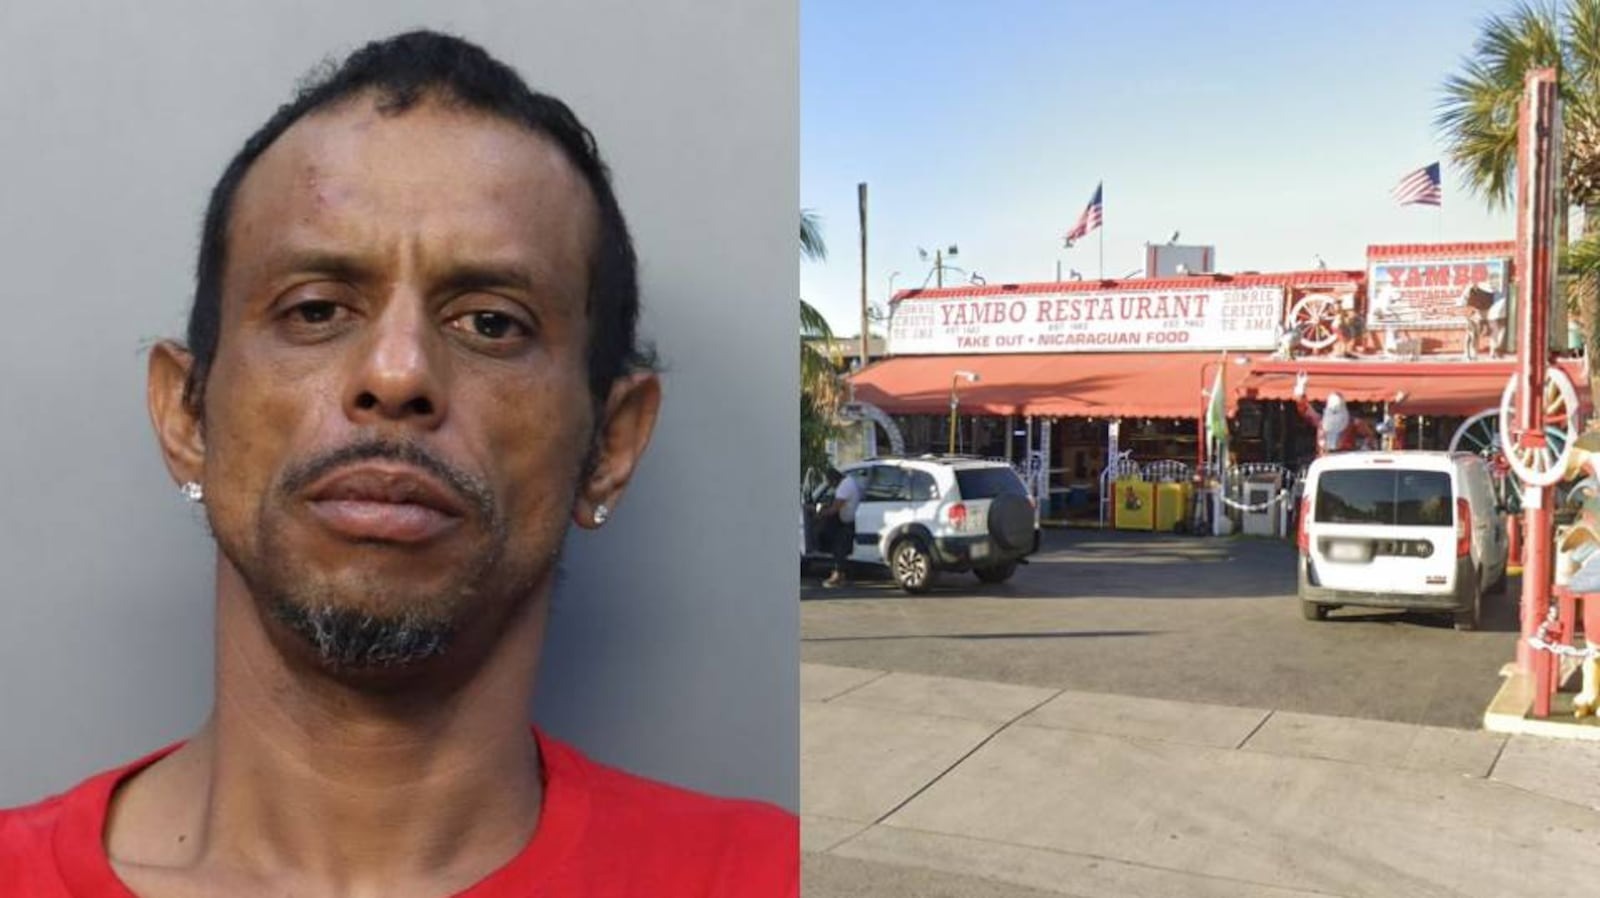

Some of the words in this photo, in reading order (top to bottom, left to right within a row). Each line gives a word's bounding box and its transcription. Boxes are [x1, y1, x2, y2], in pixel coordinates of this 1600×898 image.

[1387, 264, 1488, 287] YAMBO
[940, 301, 1026, 325] YAMBO
[1036, 295, 1209, 322] RESTAURANT
[1221, 304, 1274, 317] CRISTO
[957, 336, 989, 347] TAKE
[995, 335, 1024, 347] OUT
[1038, 332, 1140, 346] NICARAGUAN
[1146, 331, 1189, 343] FOOD
